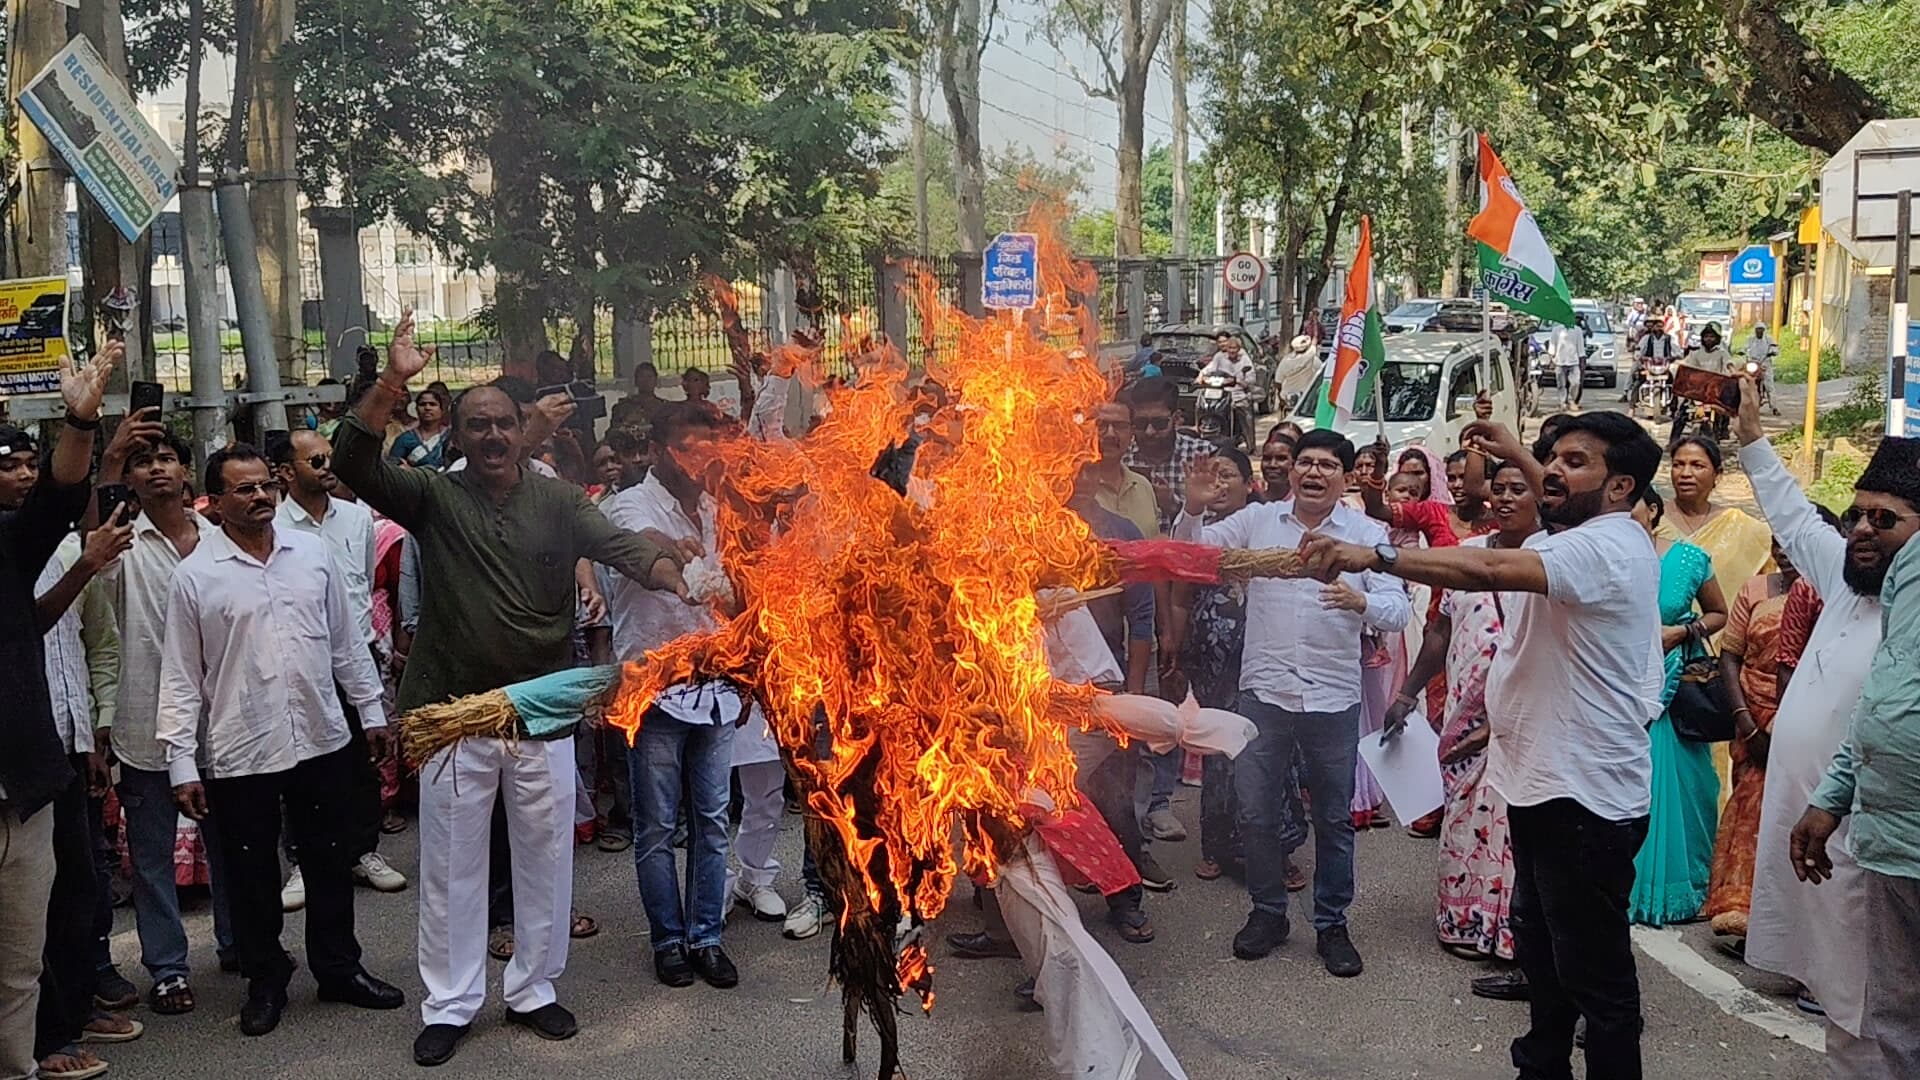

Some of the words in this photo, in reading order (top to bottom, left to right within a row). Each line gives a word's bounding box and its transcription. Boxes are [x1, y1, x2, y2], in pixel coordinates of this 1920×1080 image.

[63, 53, 143, 159] RESIDENTIAL
[138, 150, 173, 198] AREA
[1238, 260, 1251, 270] GO
[1230, 272, 1256, 282] SLOW
